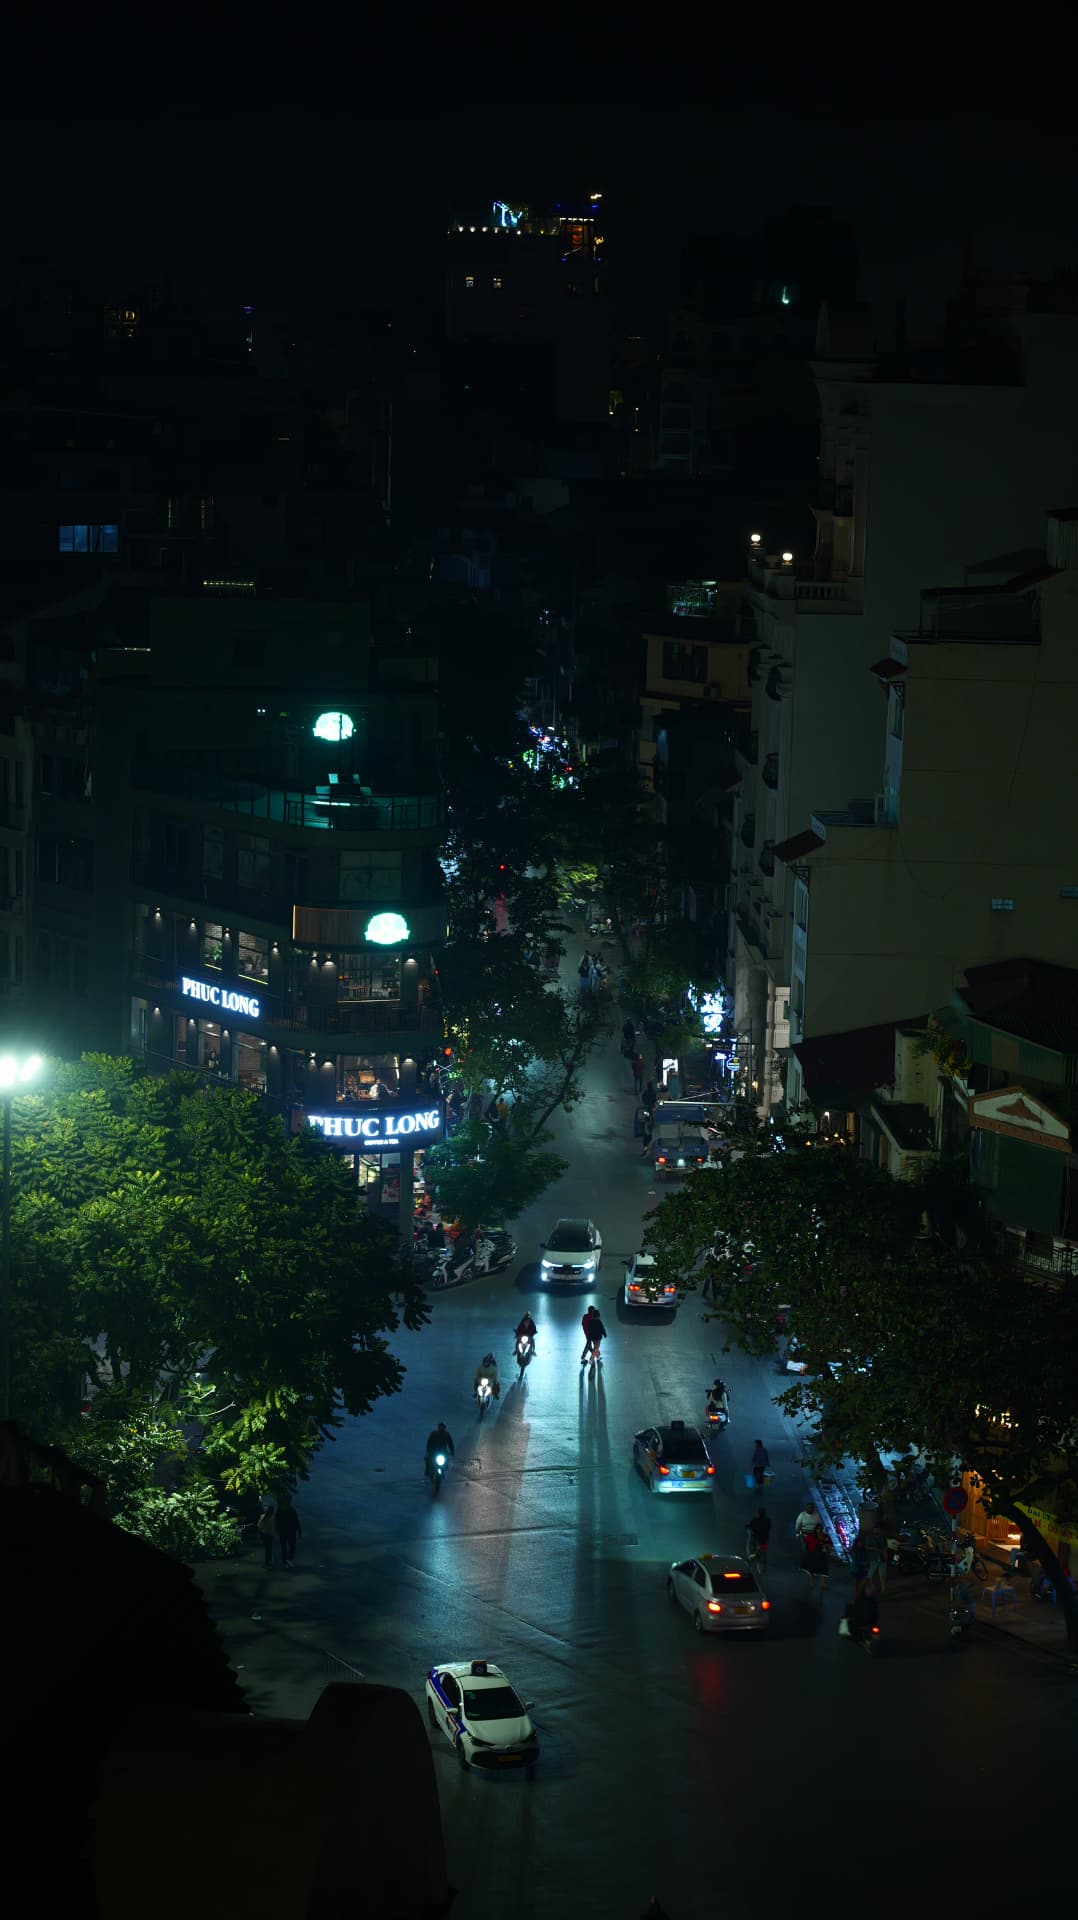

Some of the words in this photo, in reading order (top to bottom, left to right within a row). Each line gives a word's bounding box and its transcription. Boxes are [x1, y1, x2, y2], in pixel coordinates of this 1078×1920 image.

[182, 976, 220, 1005] PHUC
[221, 989, 260, 1018] LONG
[385, 1110, 440, 1135] LONG
